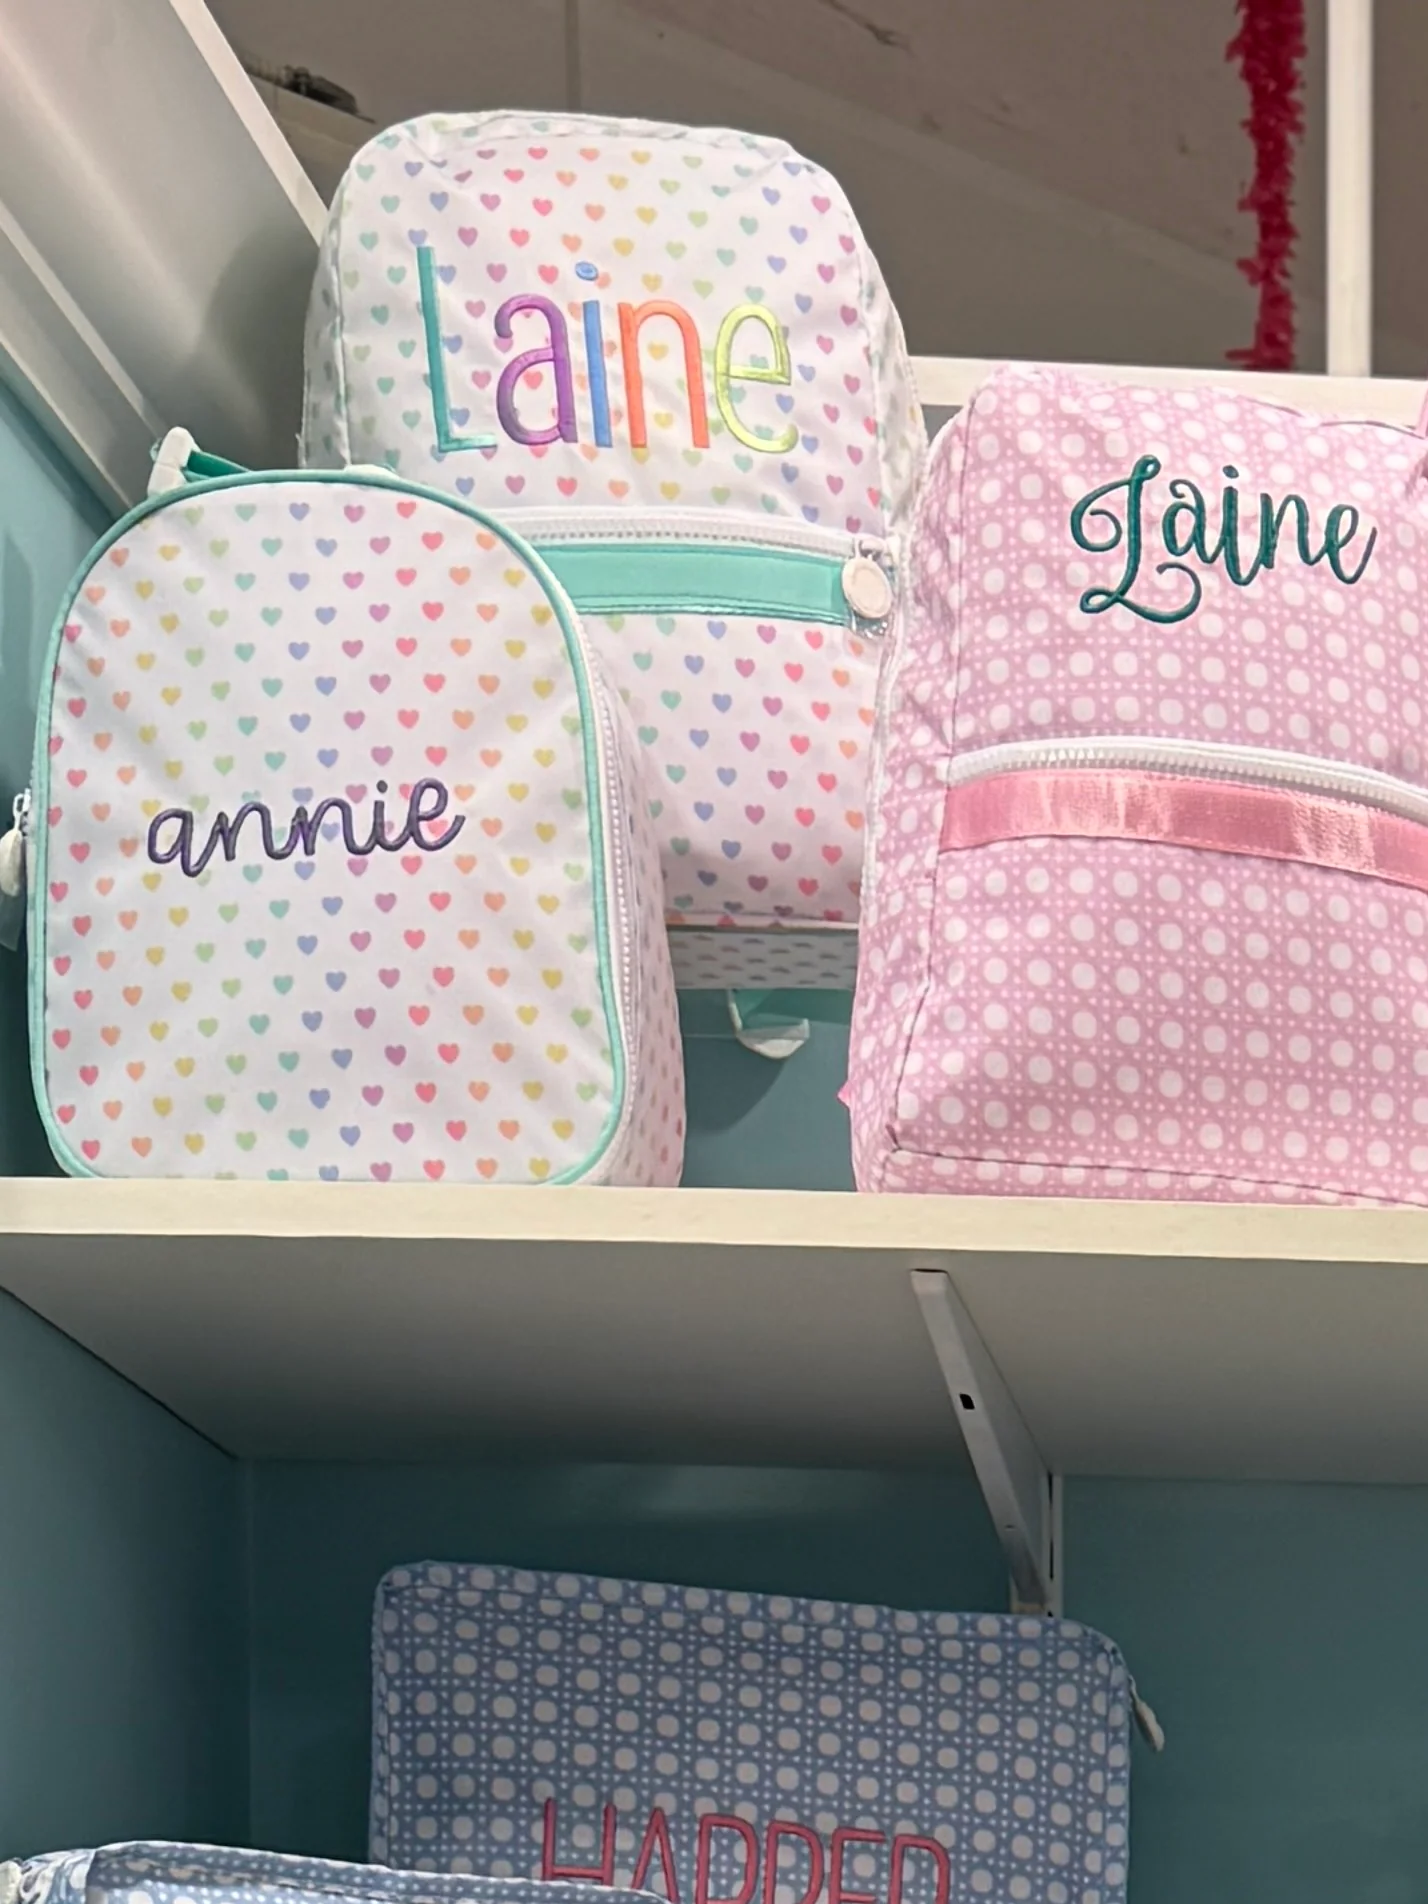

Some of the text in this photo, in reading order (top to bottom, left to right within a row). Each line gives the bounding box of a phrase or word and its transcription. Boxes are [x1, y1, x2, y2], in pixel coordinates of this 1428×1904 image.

[415, 245, 799, 456] Laine
[1070, 455, 1378, 624] Laine
[146, 777, 467, 878] annie
